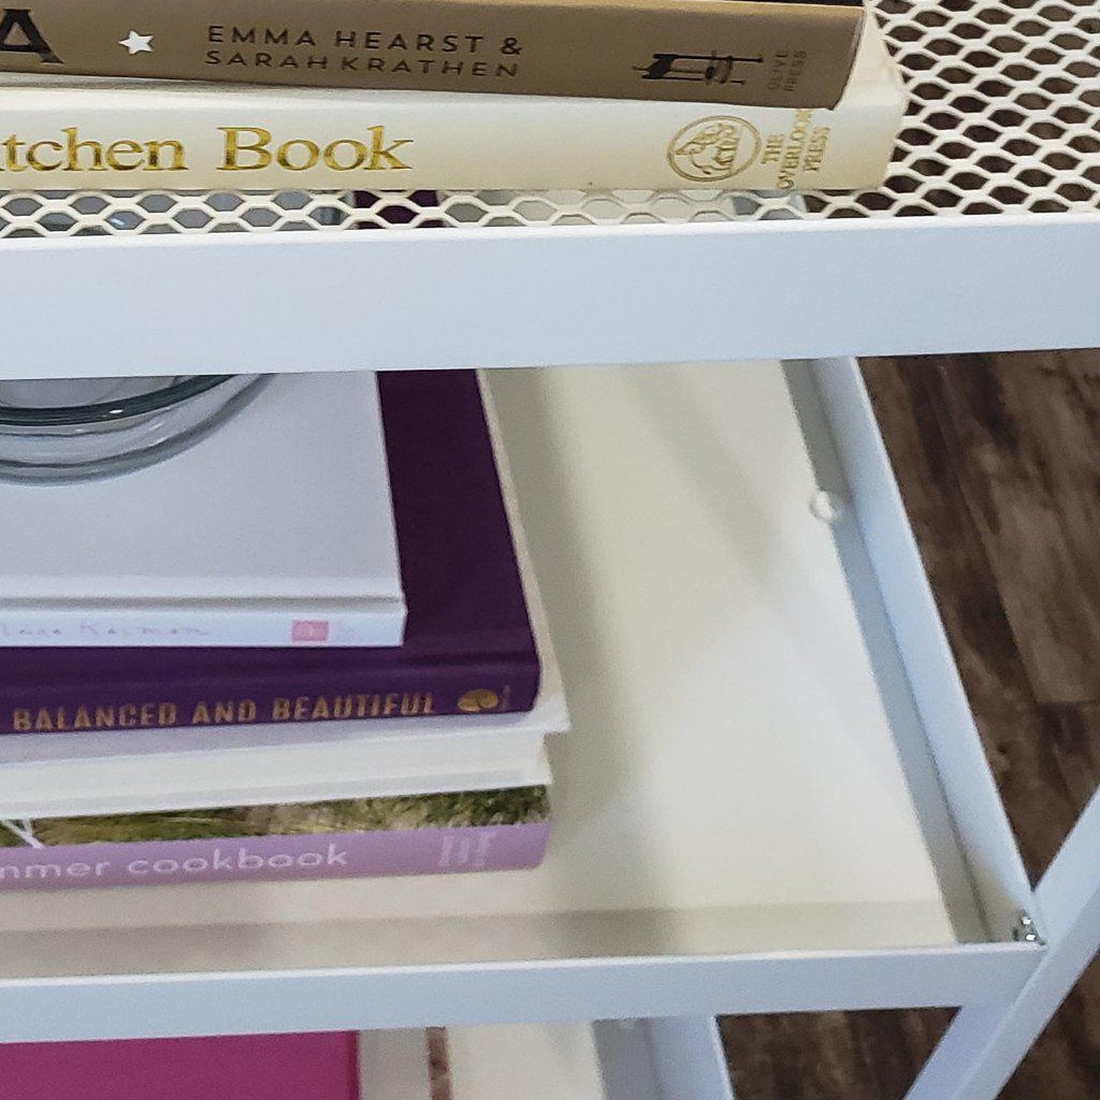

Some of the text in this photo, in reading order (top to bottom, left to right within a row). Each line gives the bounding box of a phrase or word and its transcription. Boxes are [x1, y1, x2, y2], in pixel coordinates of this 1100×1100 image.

[208, 25, 522, 55] EMMA HEARST &
[205, 51, 519, 77] SARAH KRATHEN
[216, 124, 414, 172] Book
[761, 133, 785, 165] THE
[803, 126, 830, 172] PRESS
[12, 701, 176, 733] BALANCED
[192, 699, 257, 726] AND
[272, 692, 435, 722] BEAUTIFUL
[126, 844, 349, 876] cookbook
